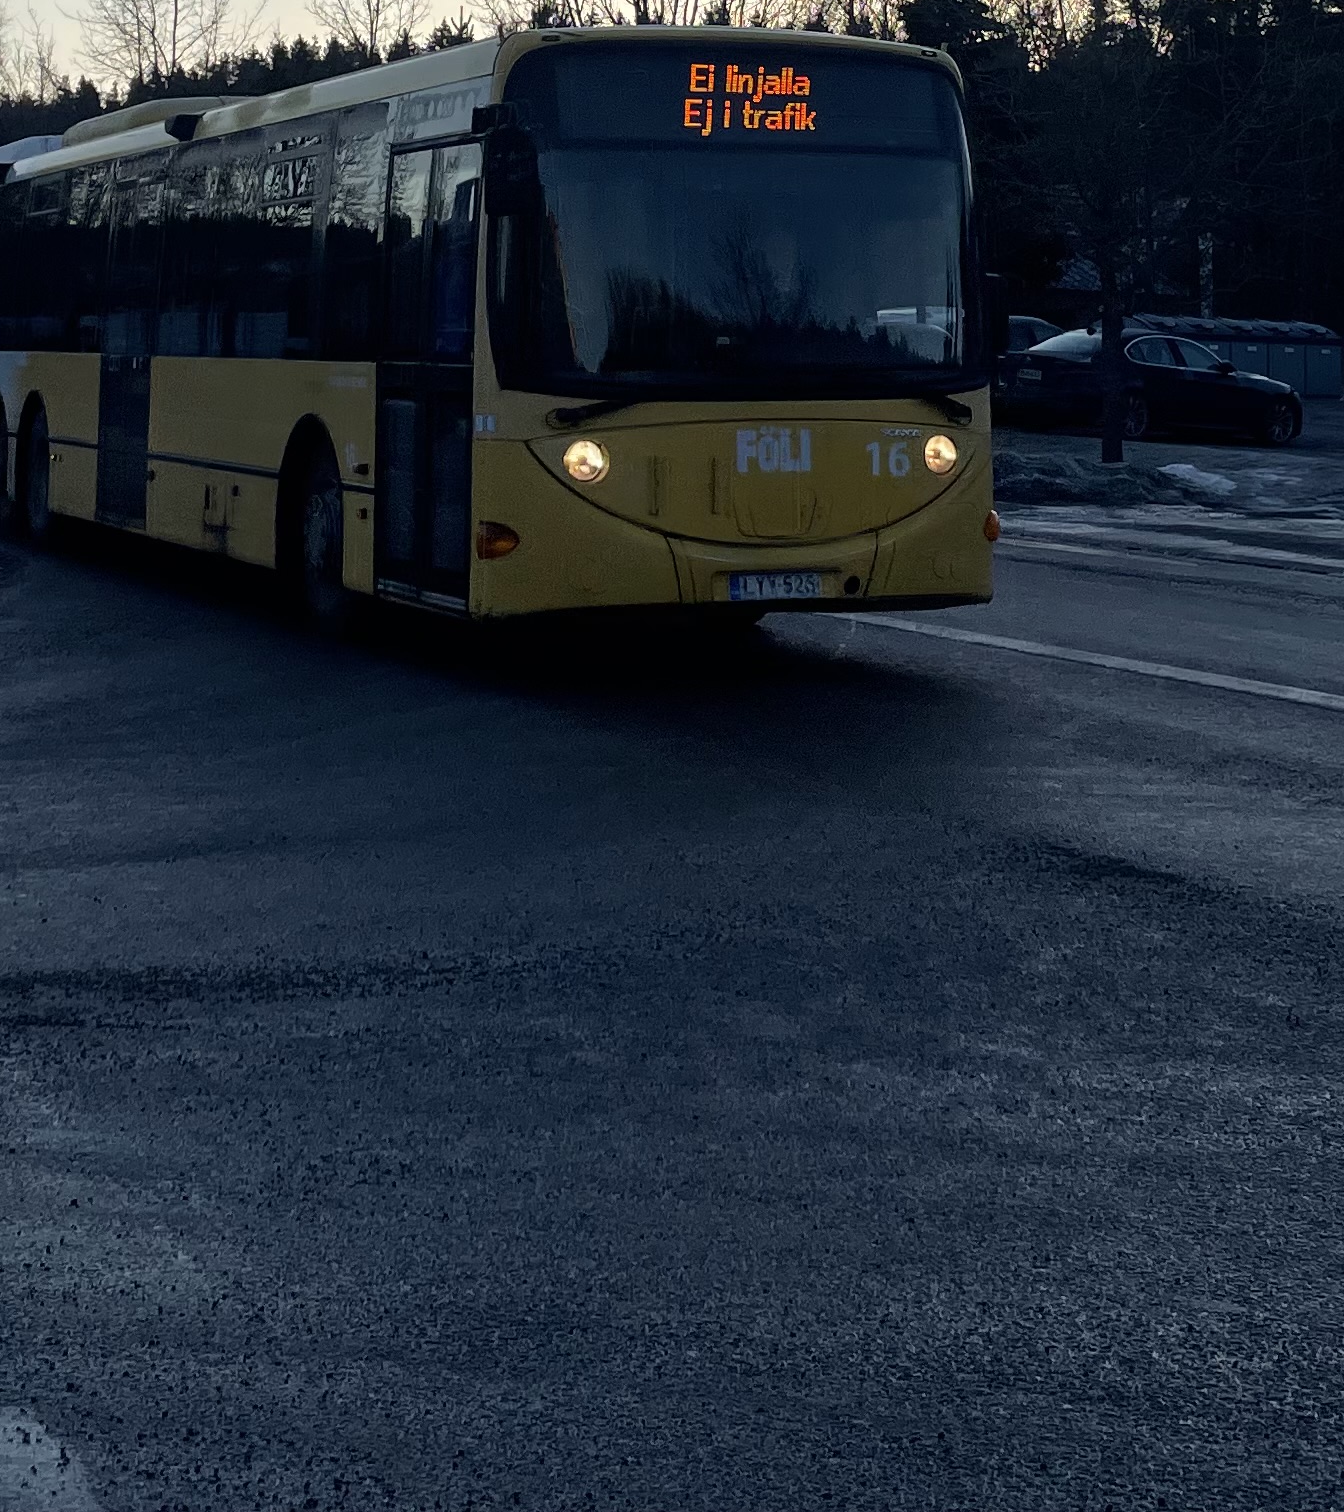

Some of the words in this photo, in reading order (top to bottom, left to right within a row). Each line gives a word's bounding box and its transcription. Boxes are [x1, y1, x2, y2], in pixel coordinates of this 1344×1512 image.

[690, 64, 715, 92] Ei
[726, 65, 810, 102] linjalla
[684, 99, 712, 137] Ej
[724, 100, 731, 128] i
[743, 101, 816, 130] trafik
[736, 426, 811, 473] FÖLI
[865, 441, 911, 477] 16
